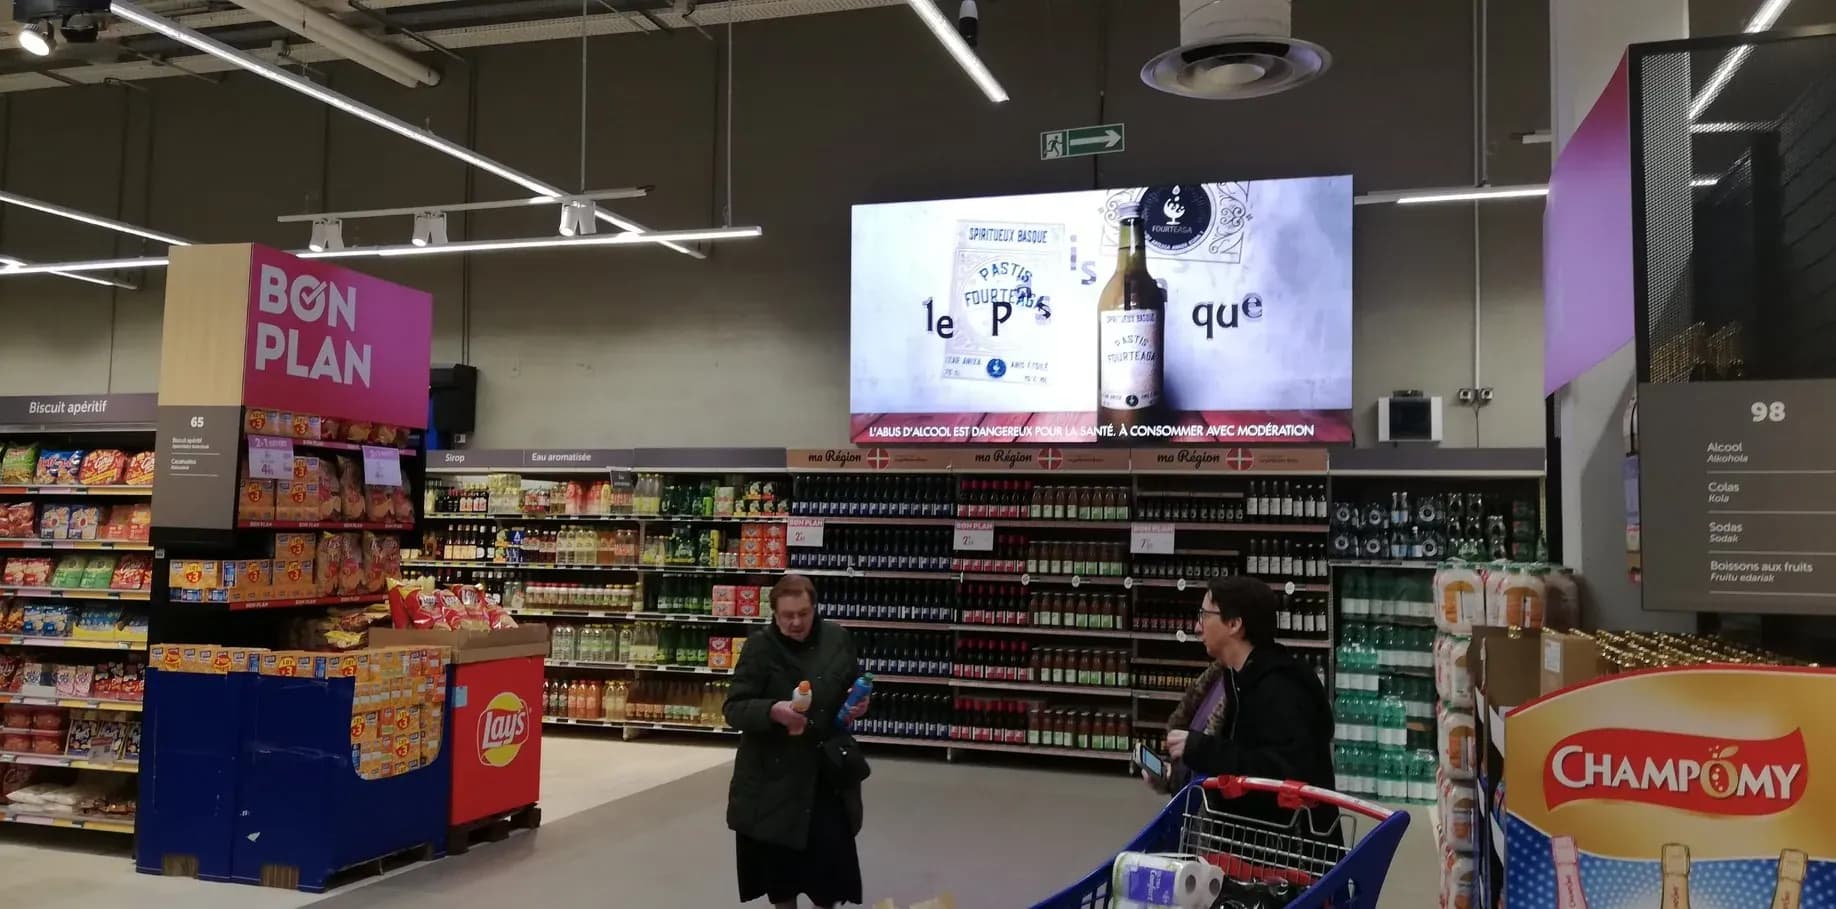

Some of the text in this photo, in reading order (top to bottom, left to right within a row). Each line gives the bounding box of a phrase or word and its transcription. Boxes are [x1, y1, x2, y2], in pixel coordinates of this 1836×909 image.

[968, 227, 1048, 243] SPIRITUEUX BASQUE
[979, 261, 1033, 283] PASTIS
[258, 264, 357, 333] BON
[1192, 293, 1263, 339] que
[254, 322, 372, 388] PLAN
[29, 400, 107, 415] Biscuit apéritif
[1750, 401, 1786, 422] 98
[190, 416, 204, 428] 65
[869, 426, 901, 437] L'ABUS
[903, 426, 951, 437] D'ALCOOL
[953, 427, 971, 437] EST
[972, 426, 1032, 437] DANGEREUX
[1035, 426, 1063, 437] POUR
[1065, 426, 1077, 437] LA
[1119, 423, 1128, 437] À
[1130, 425, 1203, 437] CONSOMMER
[1206, 425, 1235, 436] AVEC
[1237, 423, 1315, 437] MODÉRATION
[1706, 442, 1743, 452] Alcool
[445, 452, 465, 464] Sirop
[531, 452, 592, 462] Eau aromatisée
[808, 449, 861, 468] ma Région
[975, 449, 1032, 468] ma Région
[1157, 449, 1220, 469] ma Région
[1706, 453, 1748, 463] Alkohola
[1708, 482, 1740, 492] Colas
[1708, 494, 1729, 503] Kola
[1708, 522, 1743, 533] Sodas
[1709, 534, 1739, 543] Sodak
[1710, 560, 1813, 573] Boissons aux fruits
[1710, 572, 1775, 583] Fruitu edariak
[482, 707, 526, 750] Lay's
[1551, 744, 1802, 800] CHAMPOMY
